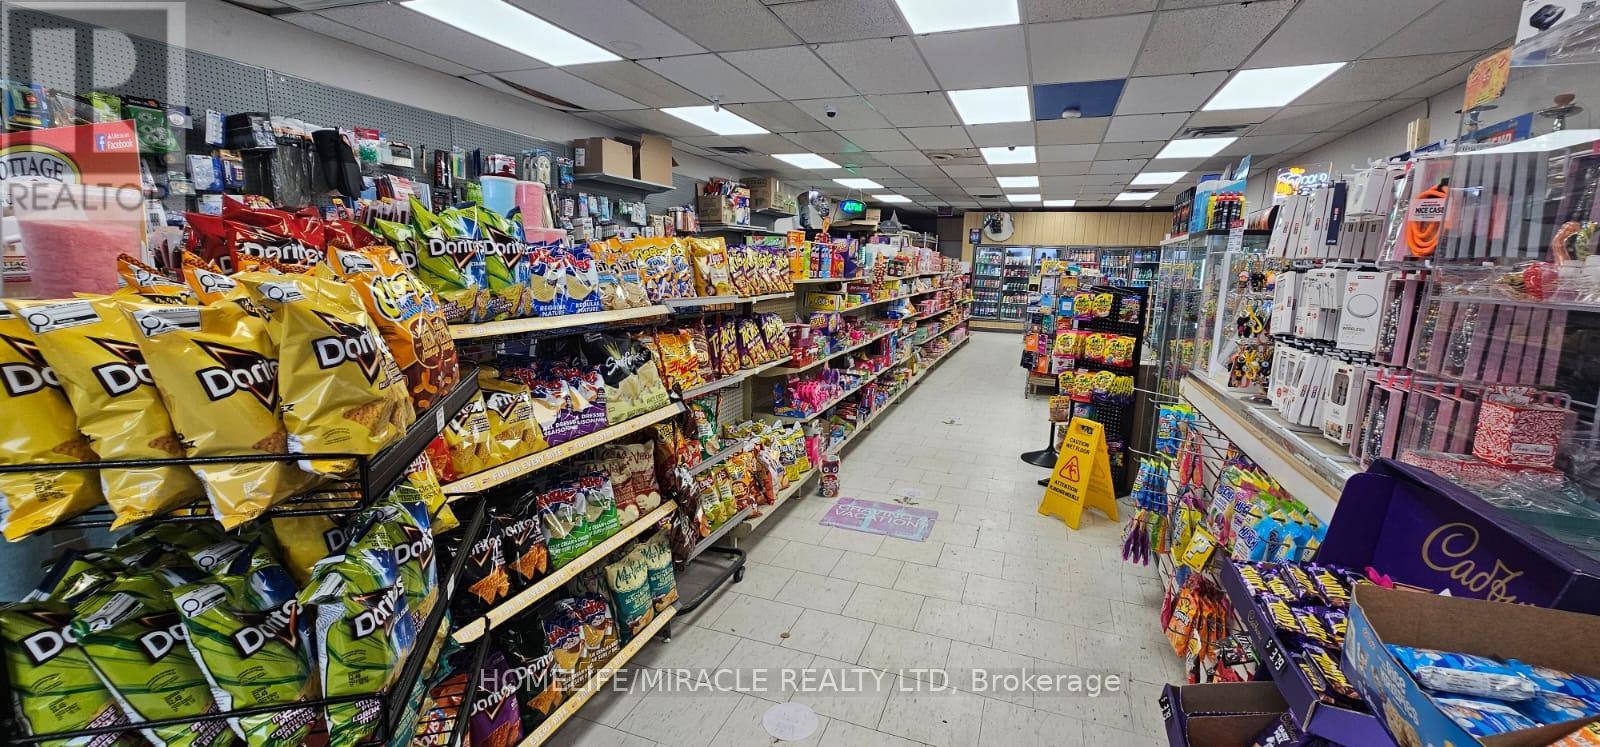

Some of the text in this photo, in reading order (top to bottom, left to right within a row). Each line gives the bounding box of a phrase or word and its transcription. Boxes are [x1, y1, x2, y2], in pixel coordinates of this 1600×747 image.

[1415, 207, 1428, 215] NICE
[1069, 437, 1090, 448] CAUTION
[835, 509, 919, 528] VACATION
